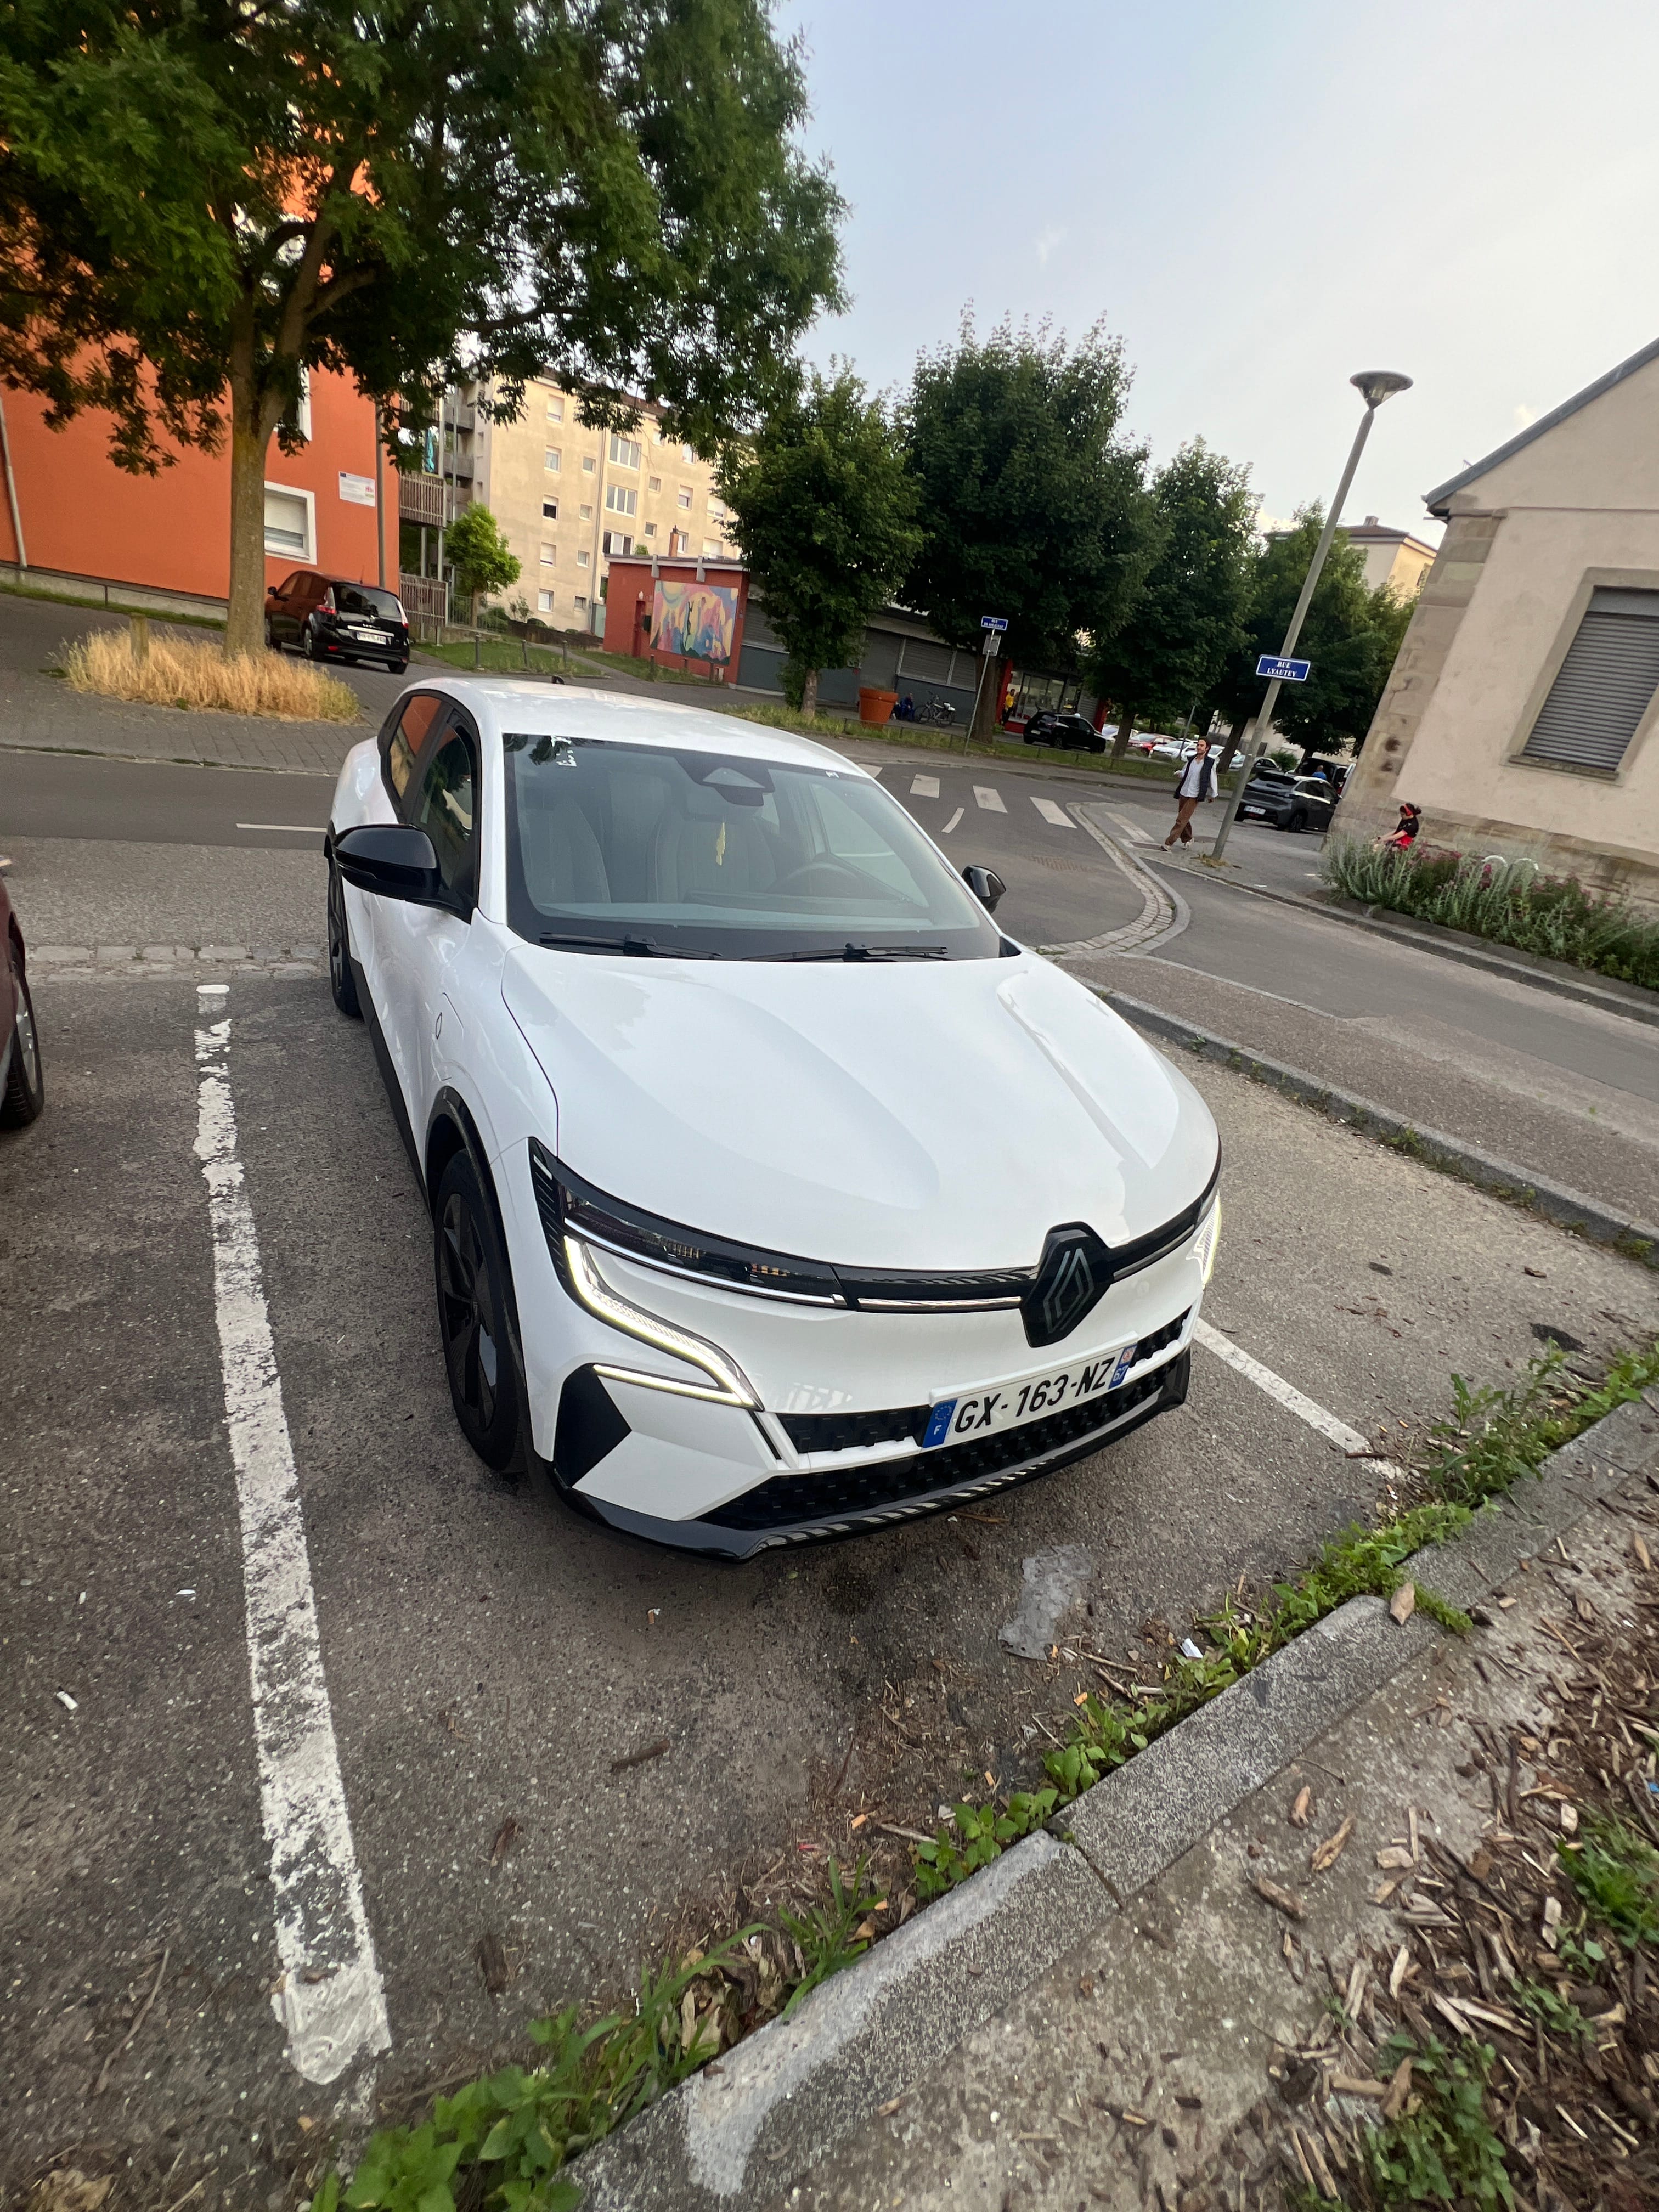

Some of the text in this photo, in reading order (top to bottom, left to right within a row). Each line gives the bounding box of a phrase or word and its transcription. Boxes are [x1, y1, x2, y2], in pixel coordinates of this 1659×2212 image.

[1267, 668, 1297, 677] LYAUTEY
[1113, 1365, 1128, 1381] 67
[955, 1357, 1115, 1433] GX-163-NZ
[934, 1425, 942, 1435] F
